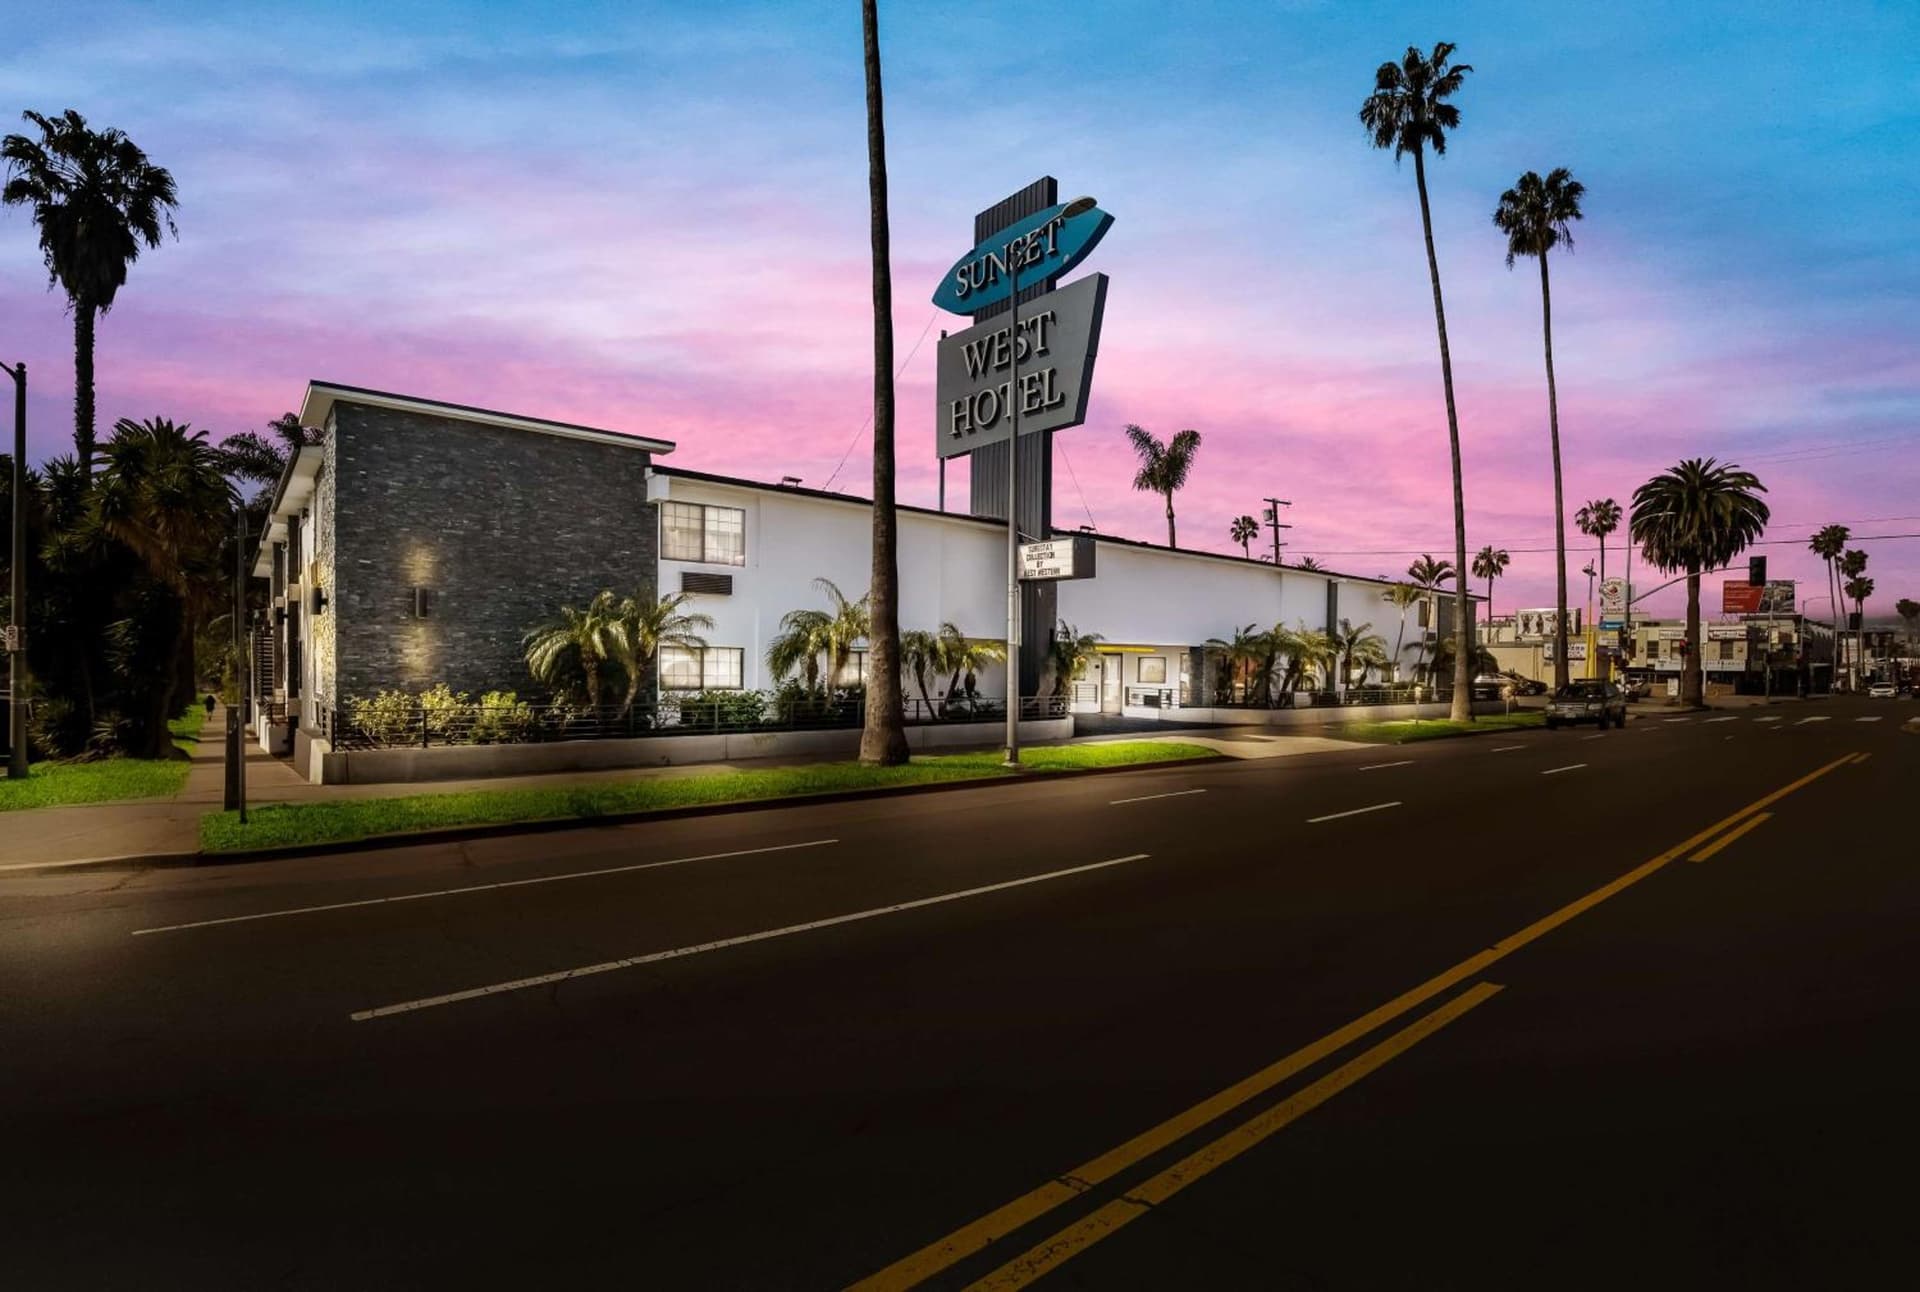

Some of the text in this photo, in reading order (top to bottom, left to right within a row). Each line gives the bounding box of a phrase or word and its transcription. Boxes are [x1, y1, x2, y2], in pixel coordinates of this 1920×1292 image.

[955, 217, 1062, 297] SUNSET
[960, 310, 1052, 378] WEST
[948, 367, 1062, 435] HOTEL
[1026, 551, 1055, 561] COLLECTION
[1036, 560, 1043, 568] BY
[1037, 567, 1060, 576] WESTERN
